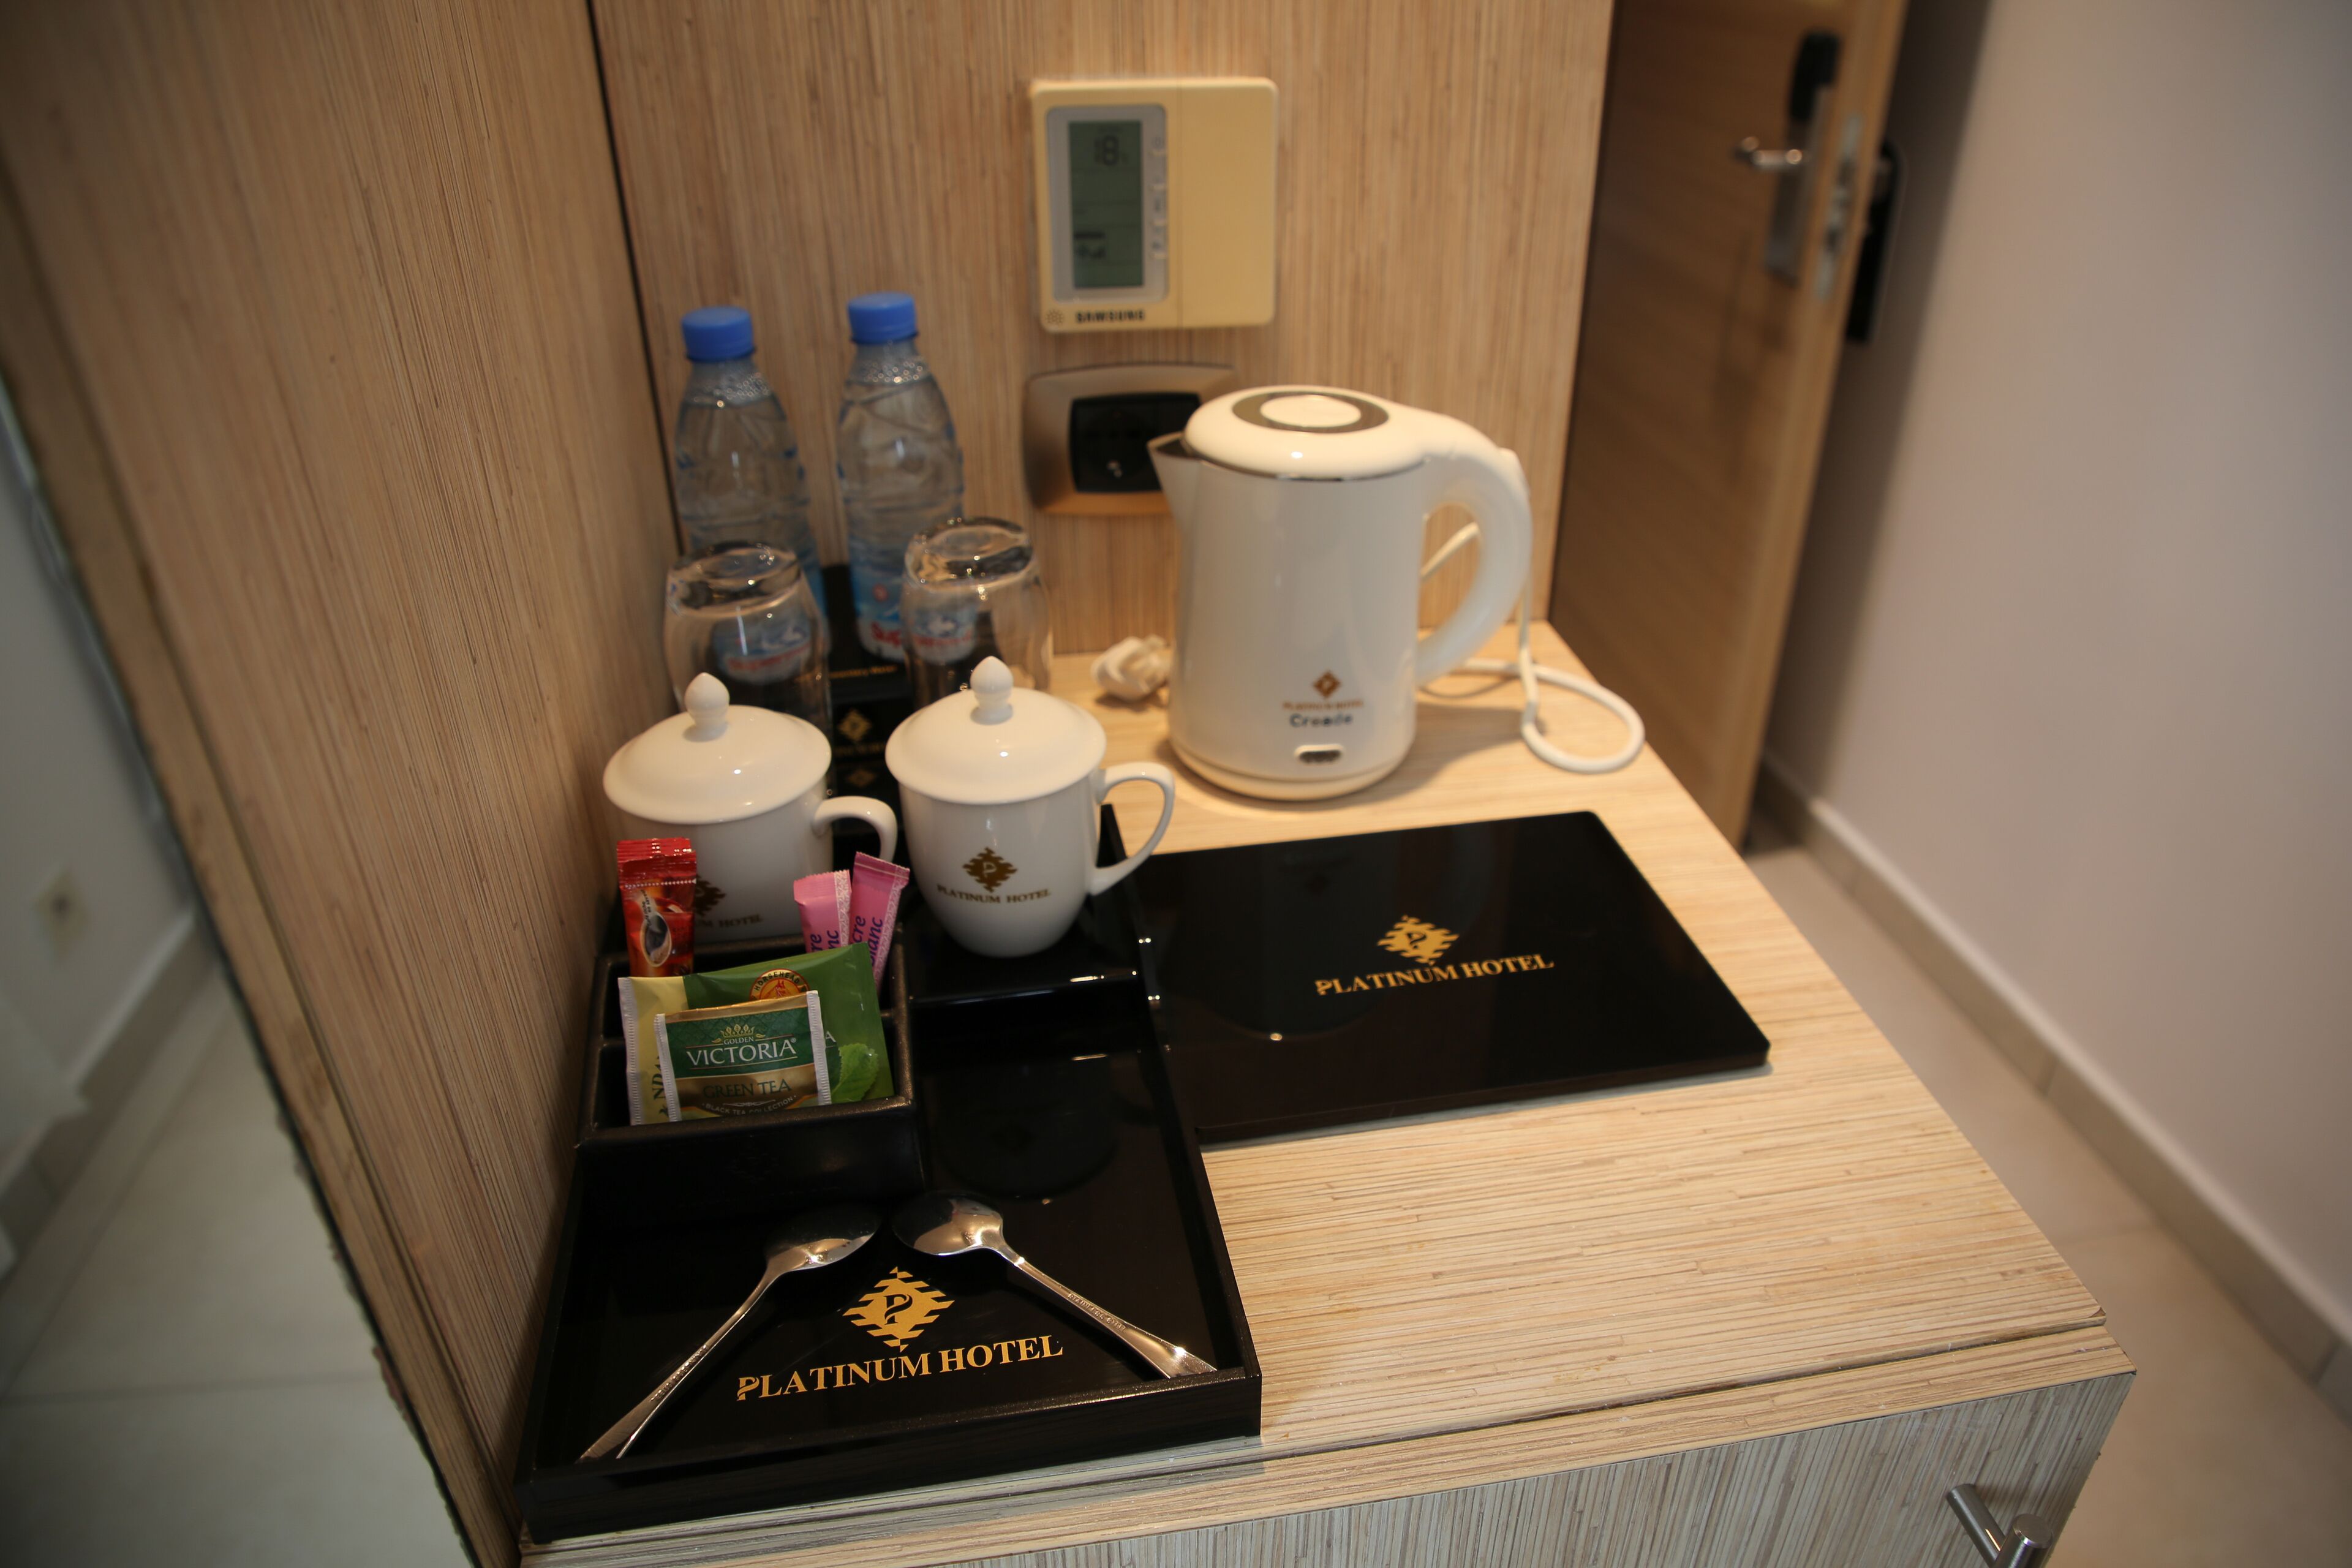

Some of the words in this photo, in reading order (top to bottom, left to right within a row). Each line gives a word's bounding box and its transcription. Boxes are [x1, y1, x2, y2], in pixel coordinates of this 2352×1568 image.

[1076, 309, 1145, 323] SAMSUNG
[937, 884, 1001, 904] PLATINUM
[1006, 889, 1051, 903] HOTEL
[1314, 963, 1459, 995] PLATINUM
[1460, 954, 1555, 979] HOTEL
[723, 1036, 754, 1046] GOLDEN
[686, 1039, 796, 1066] VICTORIA
[703, 1082, 754, 1099] GREEN
[758, 1079, 793, 1095] TEA
[706, 1103, 730, 1114] BLACK
[736, 1352, 933, 1401] PLATINUM
[939, 1335, 1063, 1372] HOTEL
